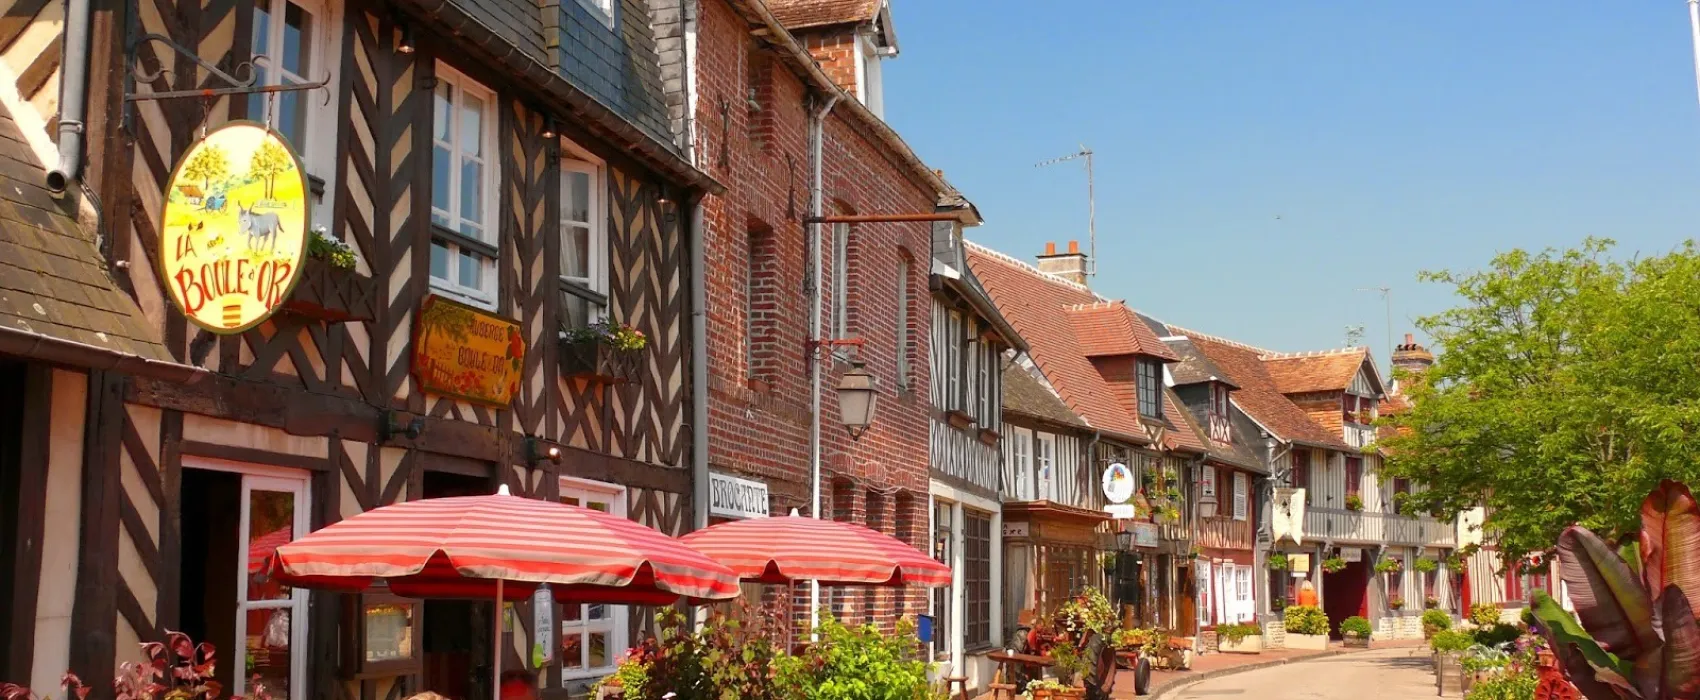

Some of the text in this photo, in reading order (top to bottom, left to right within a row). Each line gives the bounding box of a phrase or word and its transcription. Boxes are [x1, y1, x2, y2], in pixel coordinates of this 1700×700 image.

[176, 233, 198, 261] LA
[174, 258, 250, 317] BOULE
[457, 345, 487, 372] BOULE
[711, 477, 767, 515] BROCANTE
